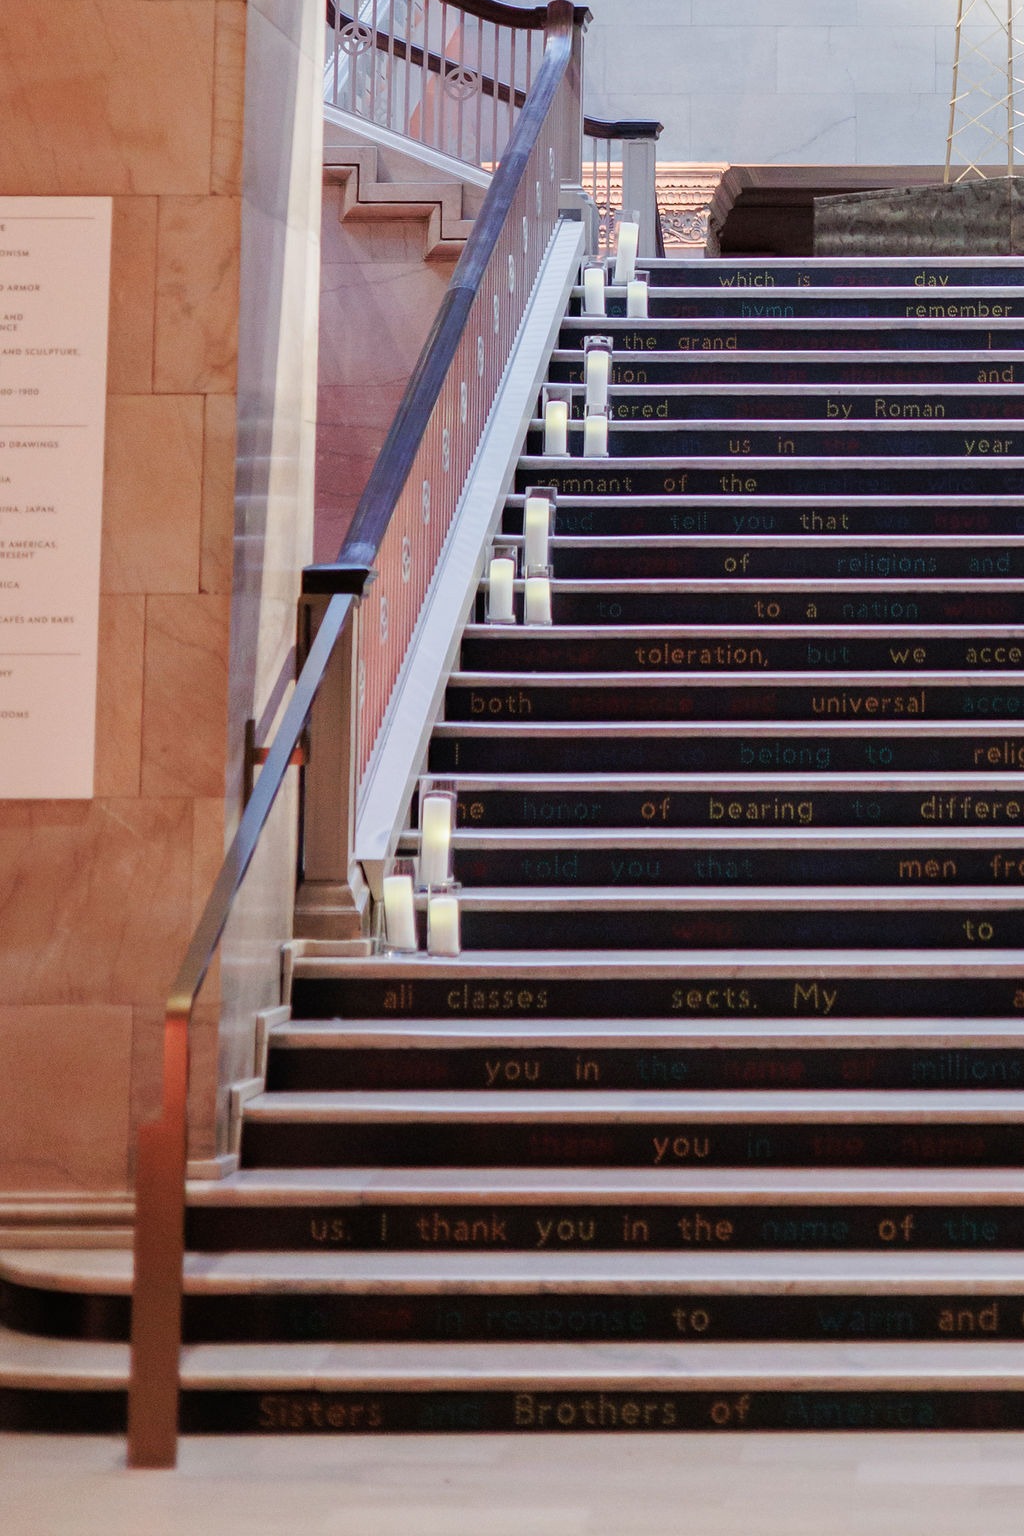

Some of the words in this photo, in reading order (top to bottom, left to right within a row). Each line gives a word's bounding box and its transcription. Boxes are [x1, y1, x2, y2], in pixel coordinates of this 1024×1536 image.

[717, 271, 776, 287] which
[796, 271, 811, 287] is
[905, 301, 1013, 319] remember
[622, 332, 658, 350] the
[677, 331, 738, 351] grand
[976, 365, 1014, 383] and
[826, 398, 853, 419] by
[874, 398, 946, 417] Roman
[728, 438, 751, 453] us
[777, 433, 795, 453] in
[963, 438, 1014, 455] year
[663, 472, 688, 492] of
[718, 472, 758, 492] the
[799, 510, 850, 530] that
[723, 551, 751, 572] of
[753, 598, 782, 619] to
[805, 602, 818, 619] a
[633, 643, 769, 667] toleration,
[888, 647, 928, 664] we
[469, 692, 534, 714] both
[811, 691, 927, 713] universal
[739, 742, 831, 770] belong
[864, 743, 893, 764] to
[639, 798, 671, 819] of
[708, 798, 814, 824] bearing
[898, 858, 959, 876] men
[961, 917, 995, 939] to
[383, 984, 415, 1009] all
[447, 984, 548, 1008] classes
[670, 985, 759, 1008] sects.
[792, 983, 838, 1013] My
[483, 1058, 541, 1085] you
[575, 1054, 602, 1080] in
[651, 1135, 710, 1164] you
[416, 1213, 508, 1240] thank
[535, 1219, 596, 1247] you
[622, 1213, 650, 1240] in
[677, 1212, 734, 1240] the
[878, 1212, 915, 1240] of
[671, 1305, 710, 1333] to
[938, 1302, 999, 1332] and
[258, 1398, 383, 1427] Sisters
[513, 1396, 678, 1425] Brothers
[708, 1395, 751, 1424] of
